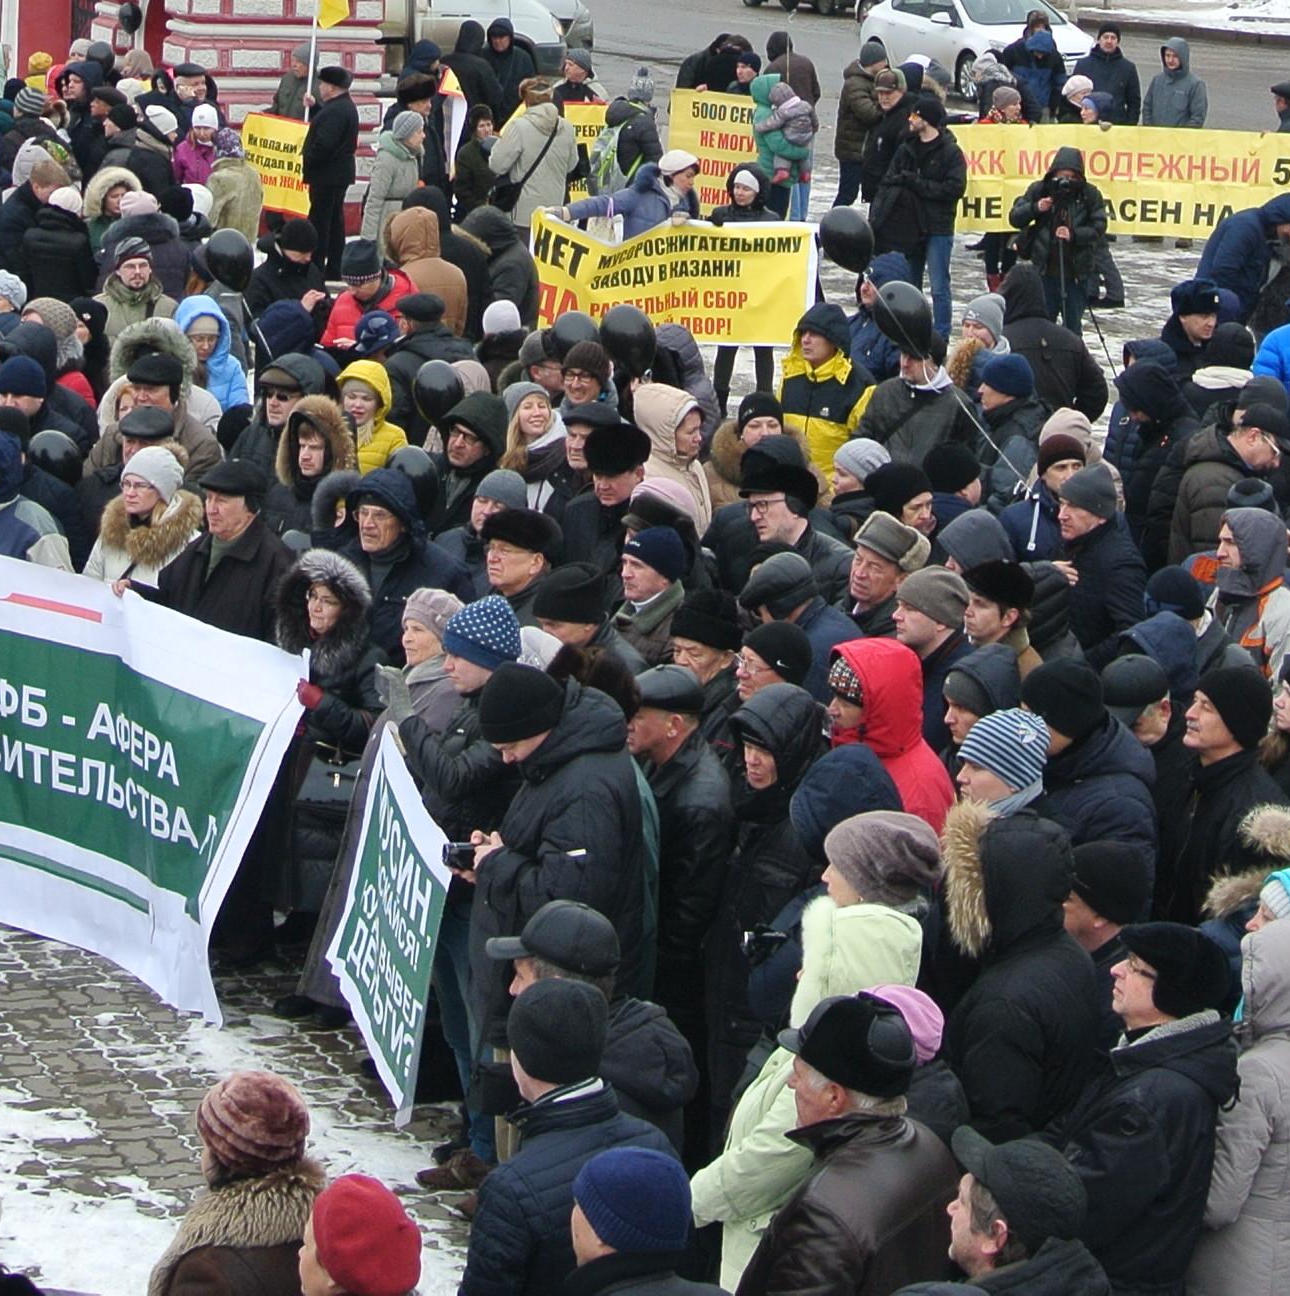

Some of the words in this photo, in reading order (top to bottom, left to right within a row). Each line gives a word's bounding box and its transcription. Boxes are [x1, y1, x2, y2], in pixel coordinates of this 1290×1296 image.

[692, 101, 727, 121] 5000
[700, 130, 715, 147] НЕ
[718, 133, 755, 153] МОГУ
[963, 149, 1006, 175] ЖК
[1019, 149, 1260, 184] МООДЕЖНЫЙ
[700, 187, 731, 205] ЖИЛ
[962, 195, 1003, 219] НЕ
[1103, 198, 1182, 225] АСЕН
[534, 222, 590, 279] НЕТ
[597, 235, 802, 270] МУСОРОСЖИГАТЕЛЬНОМУ
[591, 265, 654, 290] ЗАВОДУ
[659, 264, 667, 282] В
[669, 259, 741, 278] КАЗАНИ!
[590, 287, 698, 318] РАЕЛЬНЫЙ
[703, 290, 748, 310] СБОР
[86, 702, 180, 787] АФЕРА
[378, 855, 420, 971] СКАЙСЯ!
